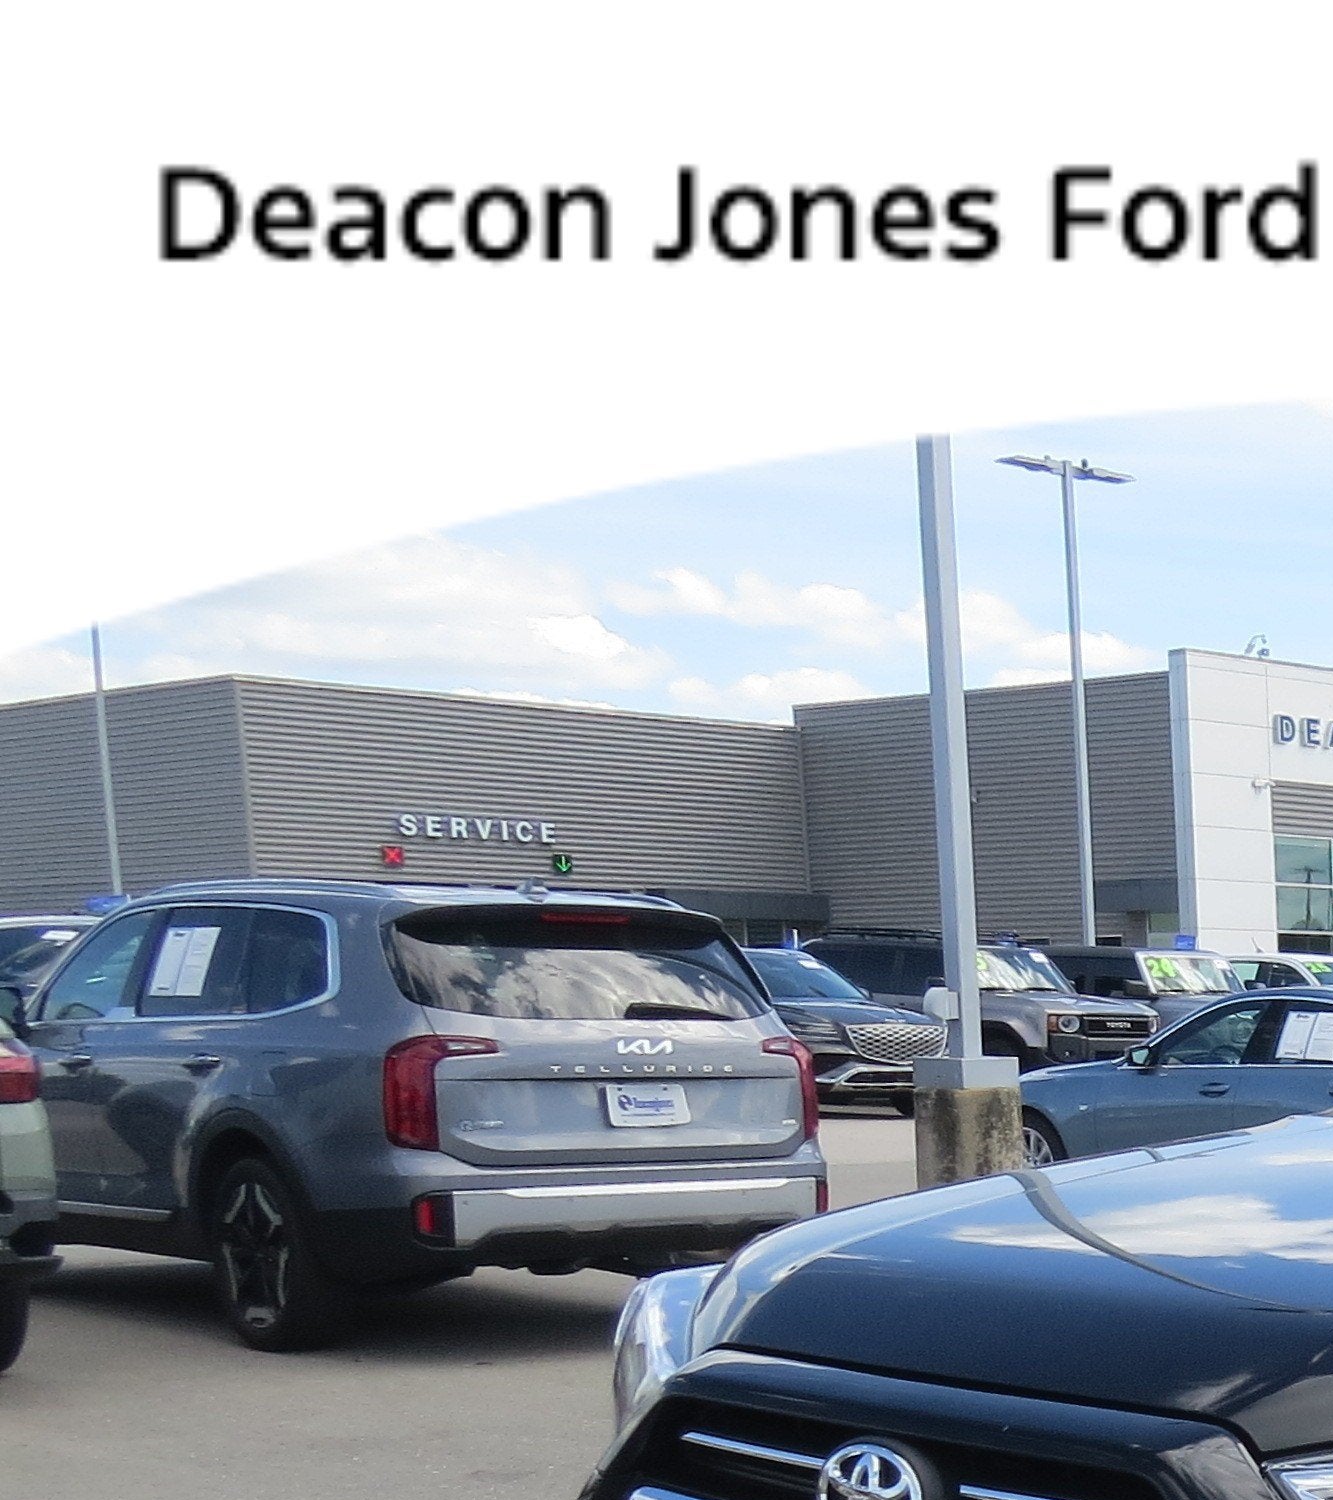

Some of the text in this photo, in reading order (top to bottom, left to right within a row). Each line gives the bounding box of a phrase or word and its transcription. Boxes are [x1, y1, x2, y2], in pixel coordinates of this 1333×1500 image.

[399, 813, 557, 844] SERVICE
[616, 1038, 674, 1055] KIA
[550, 1064, 735, 1073] TELLURIDE
